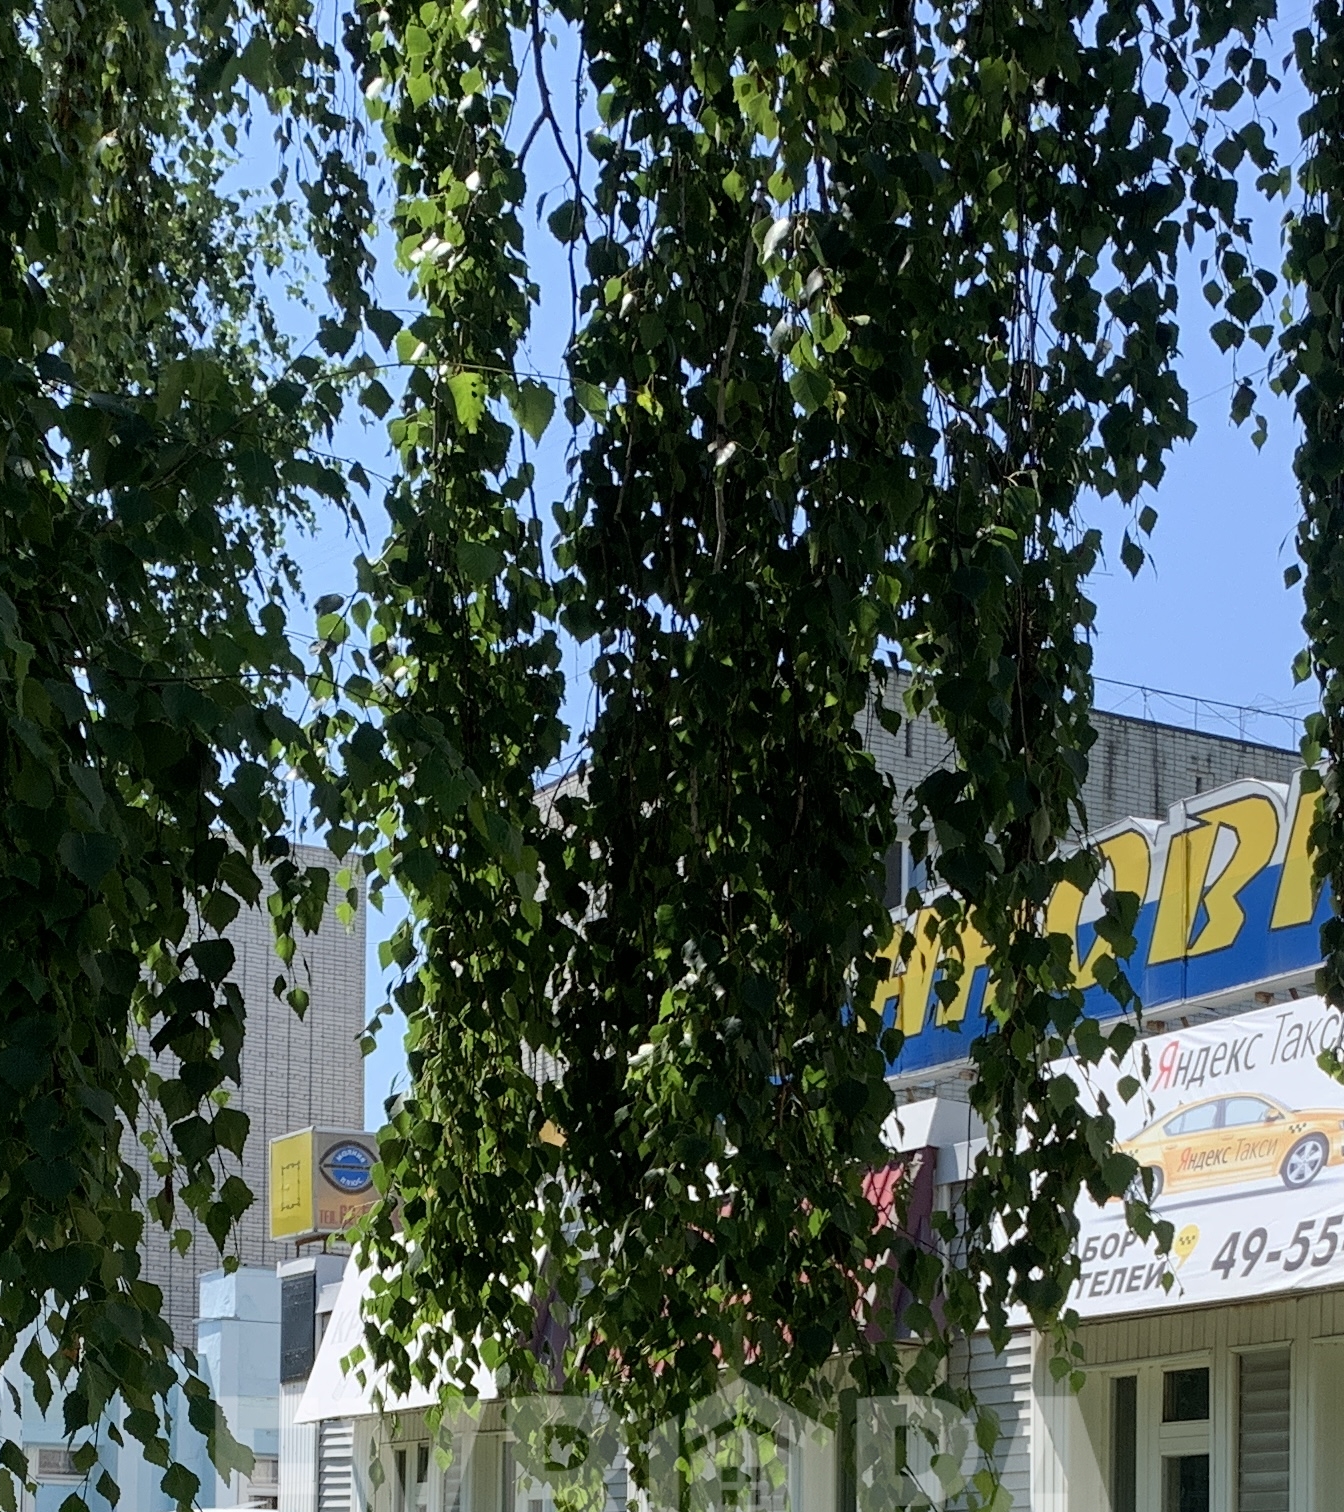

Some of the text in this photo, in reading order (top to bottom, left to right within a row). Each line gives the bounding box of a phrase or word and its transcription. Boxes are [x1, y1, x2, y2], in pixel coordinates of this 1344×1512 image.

[1151, 1032, 1263, 1092] Яндекс
[1177, 1137, 1279, 1173] Яндекс Такси
[1073, 1230, 1137, 1262] БОР
[1075, 1258, 1167, 1300] ТЕЛЕЙ
